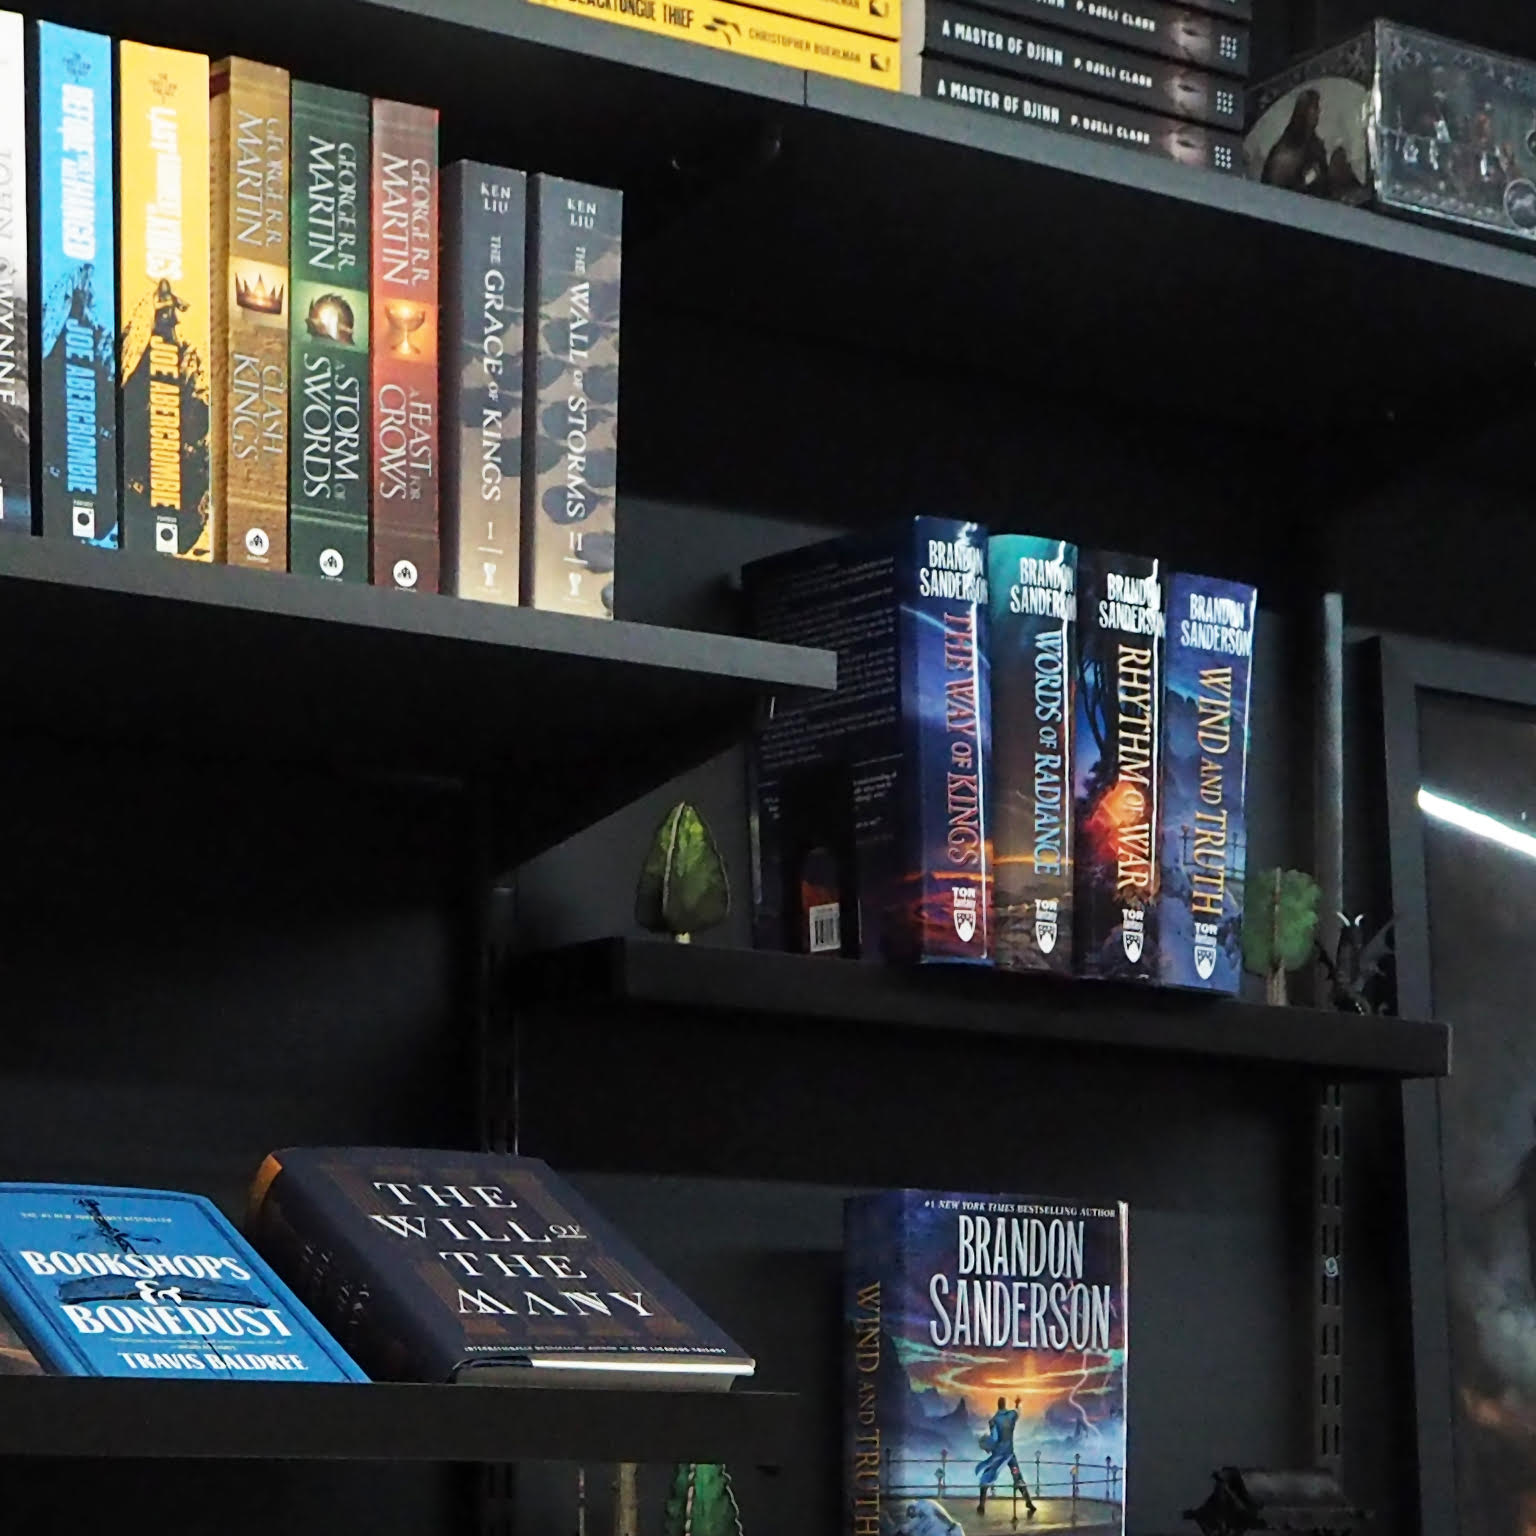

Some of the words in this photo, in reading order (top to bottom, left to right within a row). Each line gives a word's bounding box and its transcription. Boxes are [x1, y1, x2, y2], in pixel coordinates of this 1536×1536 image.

[942, 20, 950, 36] A
[955, 23, 1004, 51] MASTER
[1007, 35, 1024, 56] OF
[1026, 42, 1064, 67] DJINN
[481, 182, 511, 200] KEN
[484, 199, 509, 215] LIU
[491, 235, 502, 264] THE
[483, 269, 504, 375] GRACE
[489, 381, 498, 399] OF
[303, 353, 331, 498] SWORDS
[378, 385, 406, 500] CROWS
[482, 409, 502, 502] KINGS
[943, 612, 975, 672] THE
[1034, 630, 1063, 723] WORDS
[945, 677, 977, 741] WAY
[1036, 726, 1058, 750] OF
[950, 742, 973, 769] OF
[947, 773, 979, 866] KINGS
[1034, 753, 1062, 876] RADIANCE
[373, 1182, 517, 1209] THE
[938, 1200, 960, 1211] NEW
[962, 1201, 986, 1213] YORK
[988, 1203, 1015, 1214] TIMES
[1017, 1204, 1078, 1216] BESTSELLING
[1080, 1206, 1116, 1218] AUTHOR
[369, 1215, 552, 1243] WILL
[548, 1224, 587, 1239] OF
[958, 1214, 1085, 1279] BRANDON
[20, 1250, 251, 1280] BOOKSHOPS
[439, 1252, 587, 1279] THE
[135, 1280, 183, 1305] &
[457, 1289, 654, 1317] MANY
[60, 1304, 292, 1337] BONEDUST
[929, 1273, 1111, 1350] SANDERSON
[118, 1352, 205, 1370] TRAVIS
[206, 1352, 309, 1370] BALDREE
